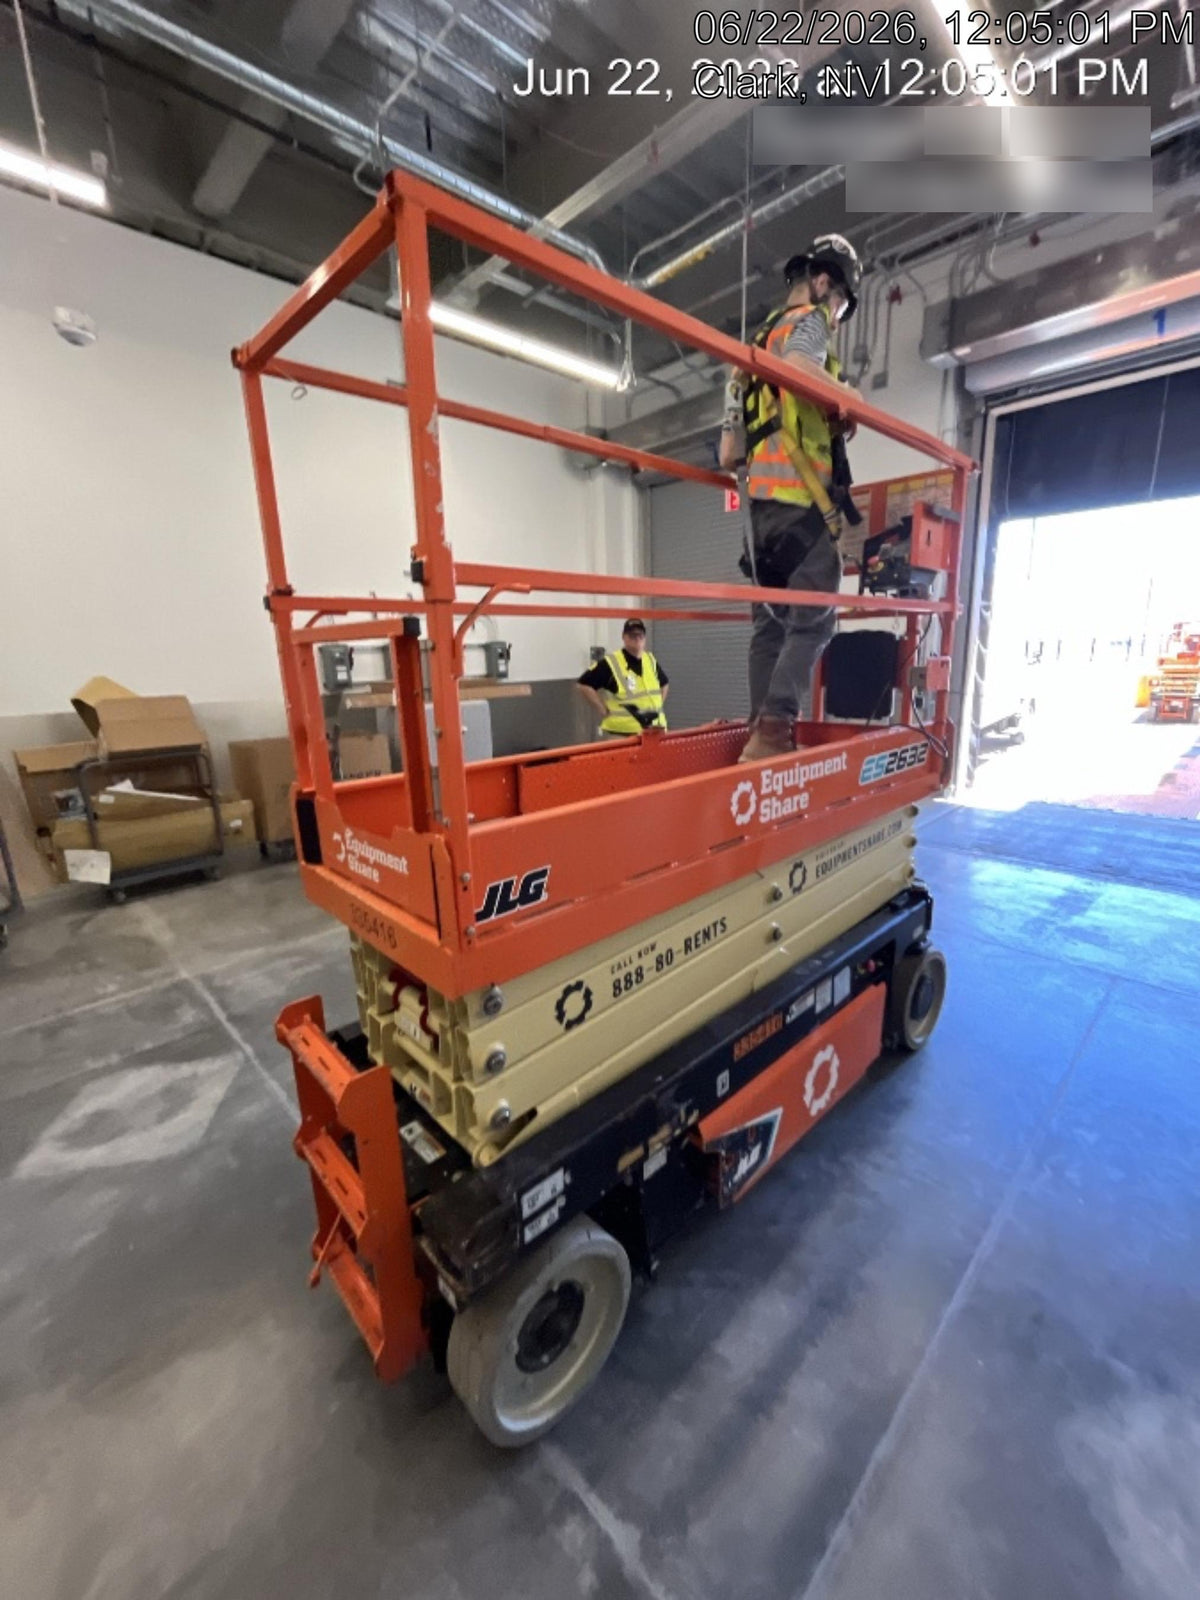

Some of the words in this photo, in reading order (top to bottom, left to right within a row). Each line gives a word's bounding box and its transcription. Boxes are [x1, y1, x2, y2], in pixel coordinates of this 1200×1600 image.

[760, 751, 848, 796] Equipment
[859, 742, 930, 787] ES2632
[759, 791, 810, 824] Share
[474, 864, 551, 926] JLG
[612, 916, 728, 998] 888-80-RENTS
